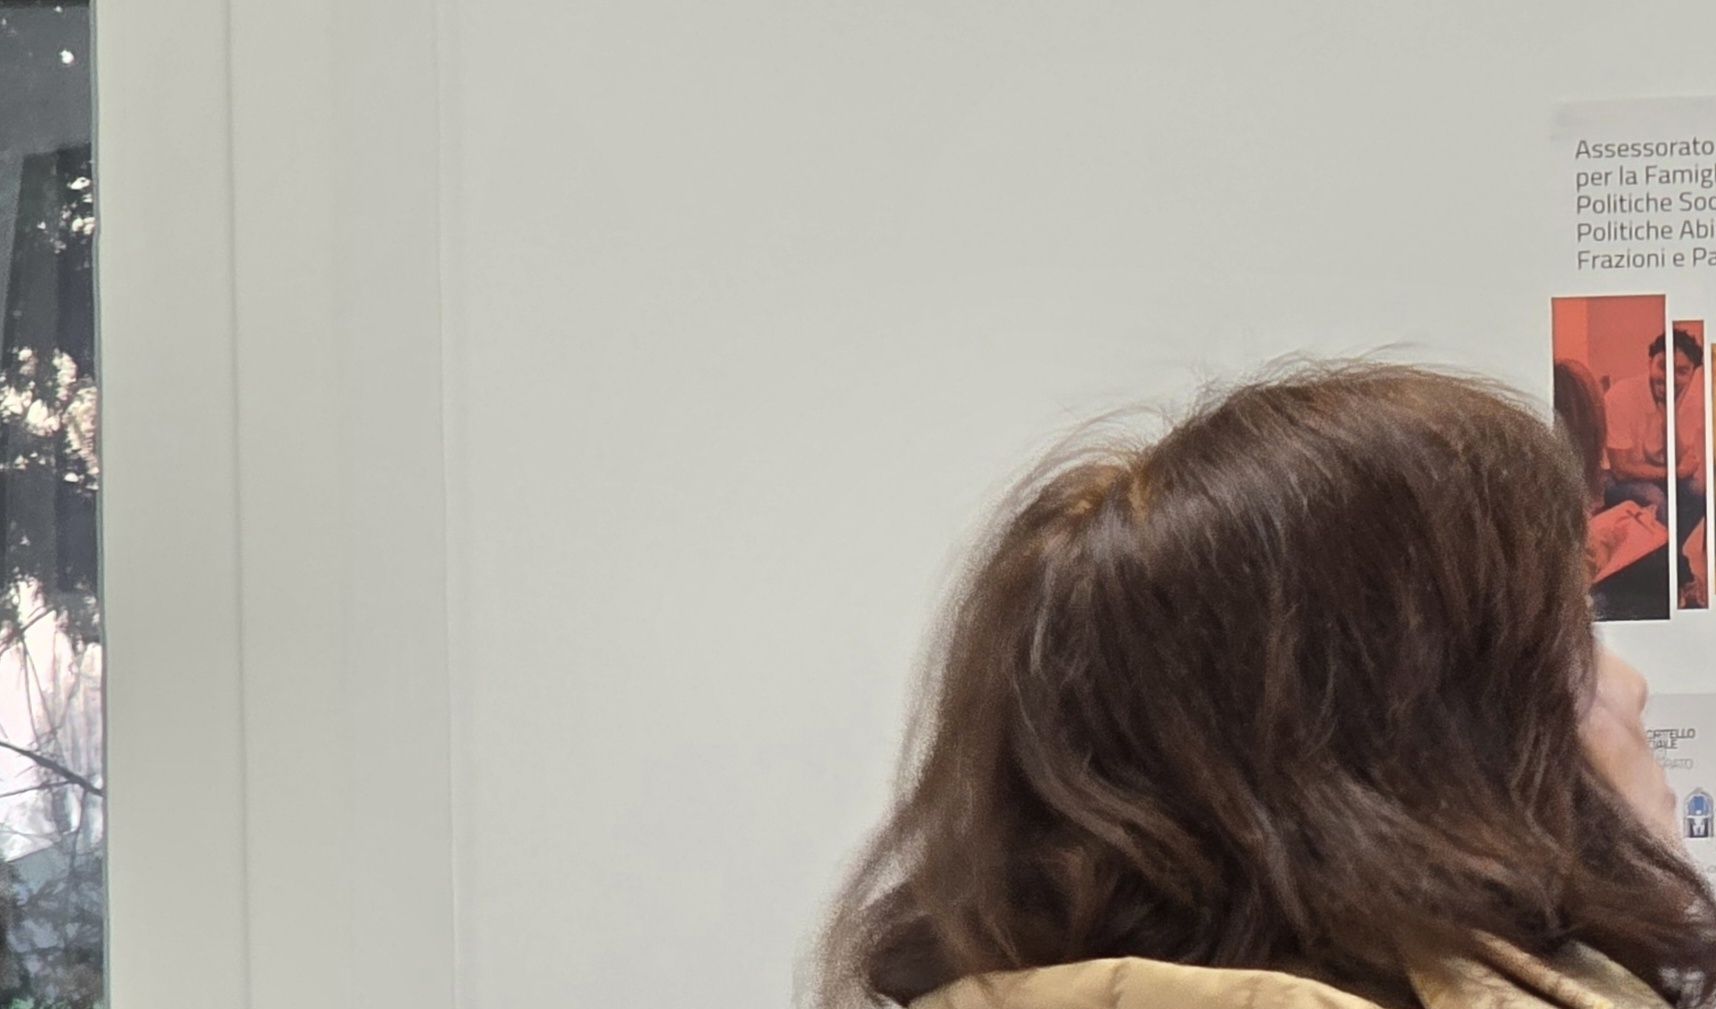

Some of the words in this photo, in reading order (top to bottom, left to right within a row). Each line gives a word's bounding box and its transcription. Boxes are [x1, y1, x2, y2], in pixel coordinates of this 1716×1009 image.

[1574, 137, 1715, 160] Assessorato
[1576, 169, 1613, 192] per
[1619, 164, 1638, 186] la
[1576, 192, 1673, 216] Politiche
[1577, 219, 1674, 243] Politiche
[1577, 247, 1666, 270] Frazioni
[1672, 252, 1685, 268] e
